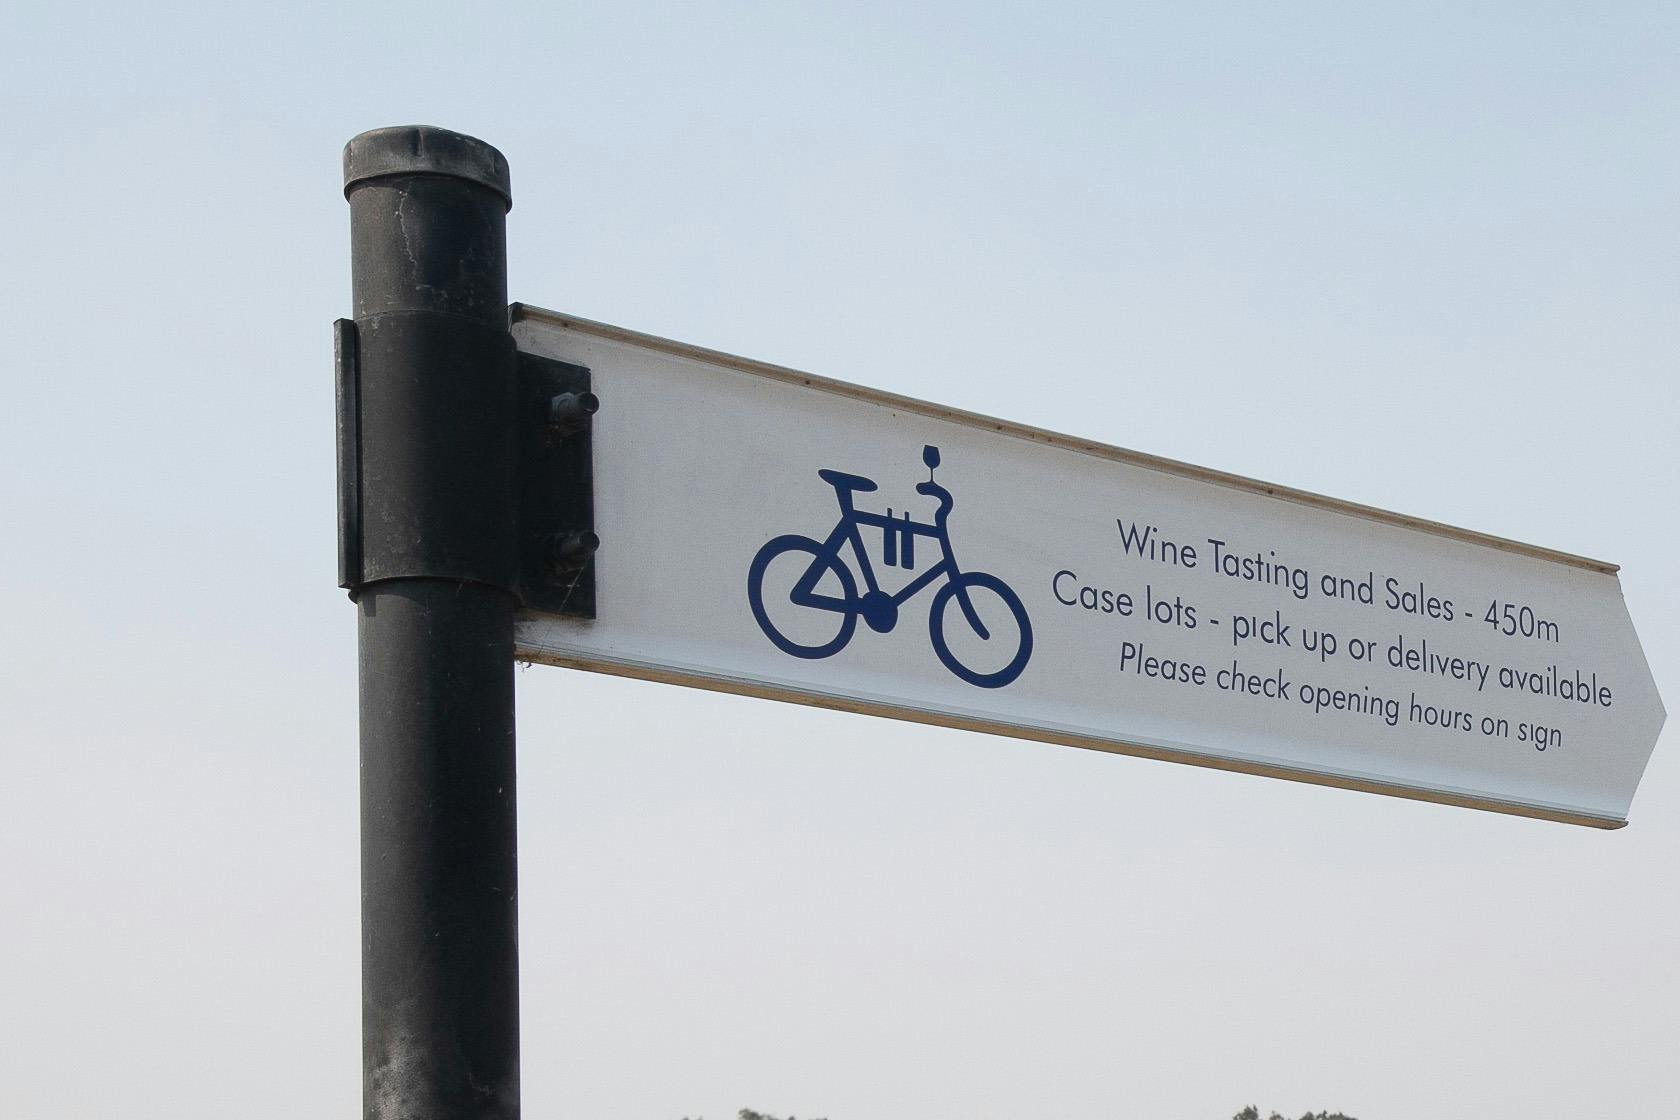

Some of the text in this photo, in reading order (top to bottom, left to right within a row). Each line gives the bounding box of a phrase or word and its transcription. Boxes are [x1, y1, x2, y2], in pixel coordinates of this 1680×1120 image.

[1052, 569, 1134, 617] Case
[1146, 584, 1197, 629] lots
[1232, 610, 1292, 647] pick
[1302, 628, 1338, 663] up
[1348, 638, 1378, 663] or
[1387, 634, 1490, 692] delivery
[1498, 664, 1613, 708] available
[1116, 518, 1197, 569] Wine
[1207, 538, 1309, 600] Tasting
[1320, 571, 1374, 605] and
[1385, 577, 1454, 622] Sales
[1483, 599, 1560, 643] 450m
[1119, 641, 1563, 752] Please check opening hours on sign
